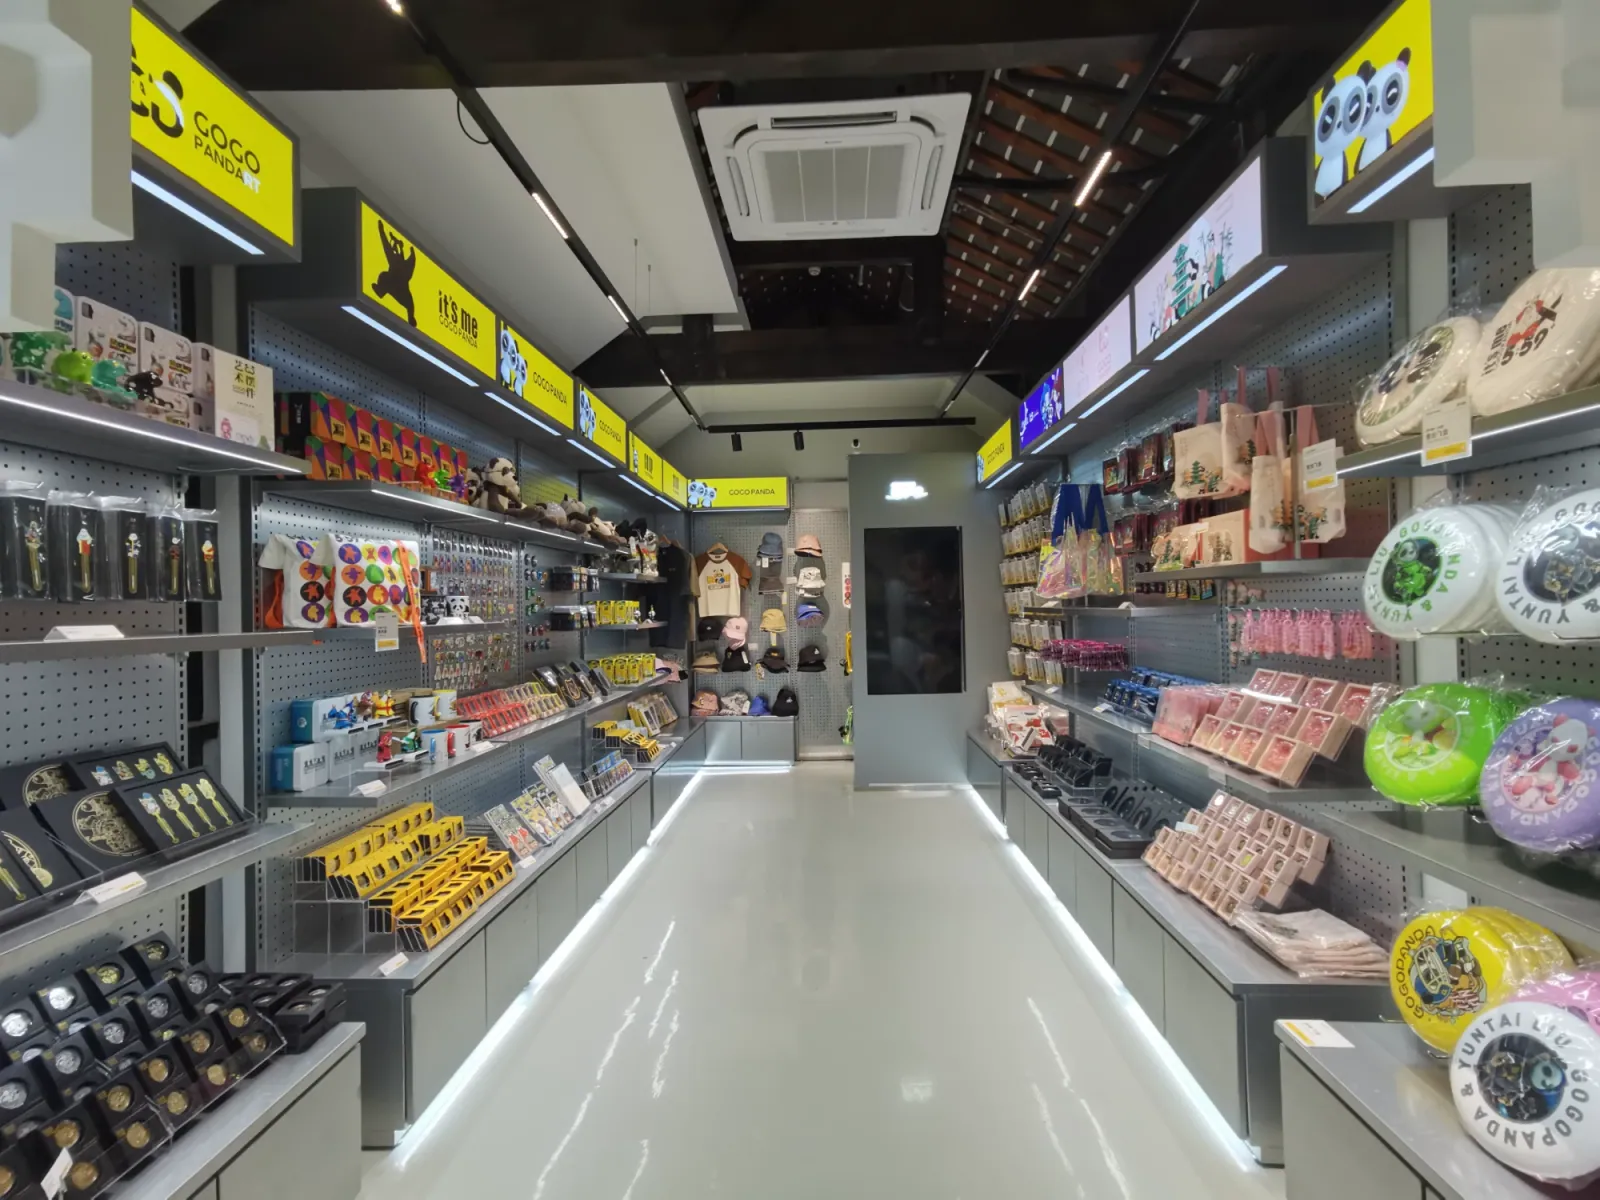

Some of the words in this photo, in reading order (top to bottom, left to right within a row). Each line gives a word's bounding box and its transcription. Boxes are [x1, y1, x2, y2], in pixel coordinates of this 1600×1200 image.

[438, 289, 458, 324] it's
[461, 307, 478, 339] me
[1503, 576, 1570, 624] YUNTAI
[1459, 1012, 1521, 1071] YUNTAI
[1532, 1021, 1574, 1048] LIU
[1460, 1082, 1475, 1097] &
[1472, 1069, 1590, 1149] GOGOPANDA
